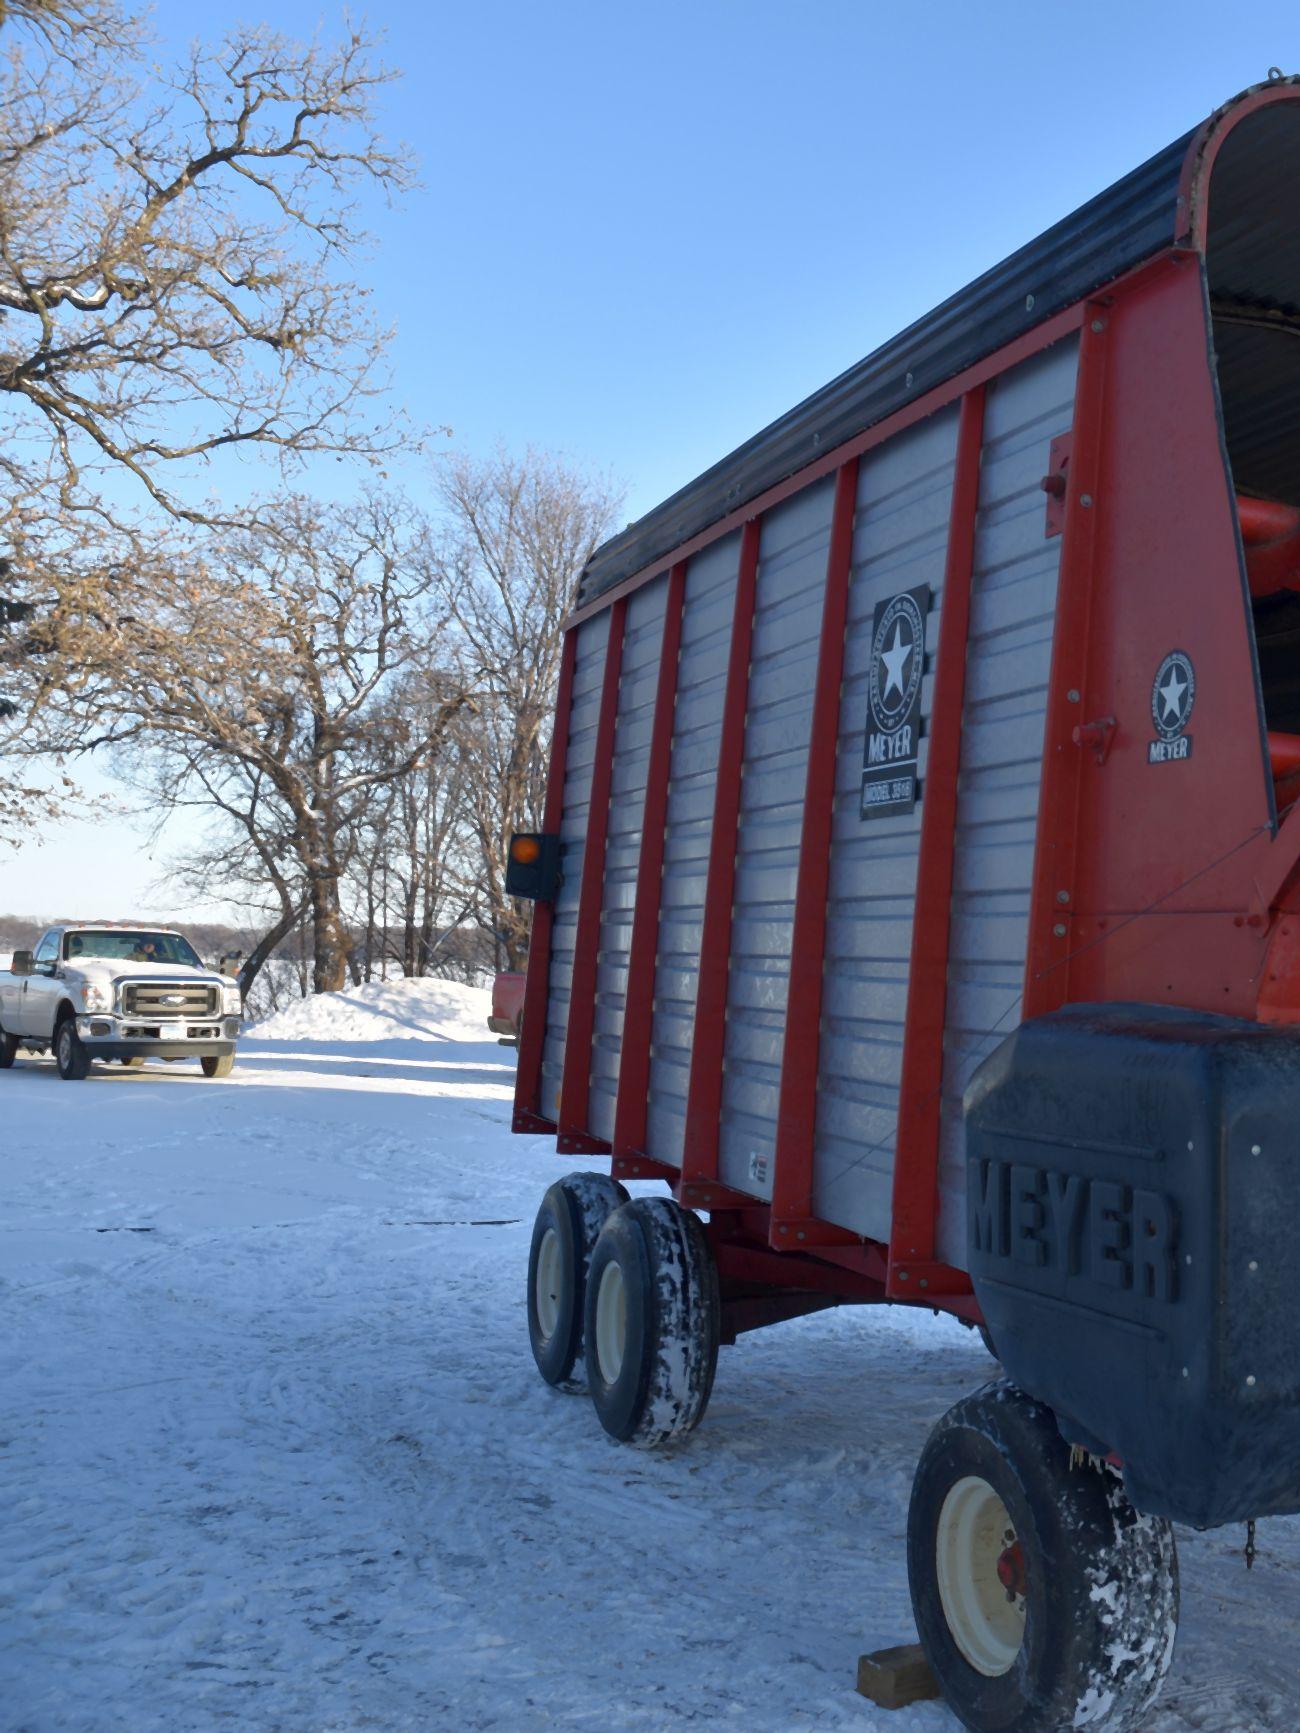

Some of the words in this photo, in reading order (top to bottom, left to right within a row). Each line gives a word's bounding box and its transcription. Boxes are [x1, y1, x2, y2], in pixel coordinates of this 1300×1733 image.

[868, 725, 911, 763] MEYER
[1149, 737, 1187, 763] MEYER
[968, 1158, 1181, 1303] MEYER
